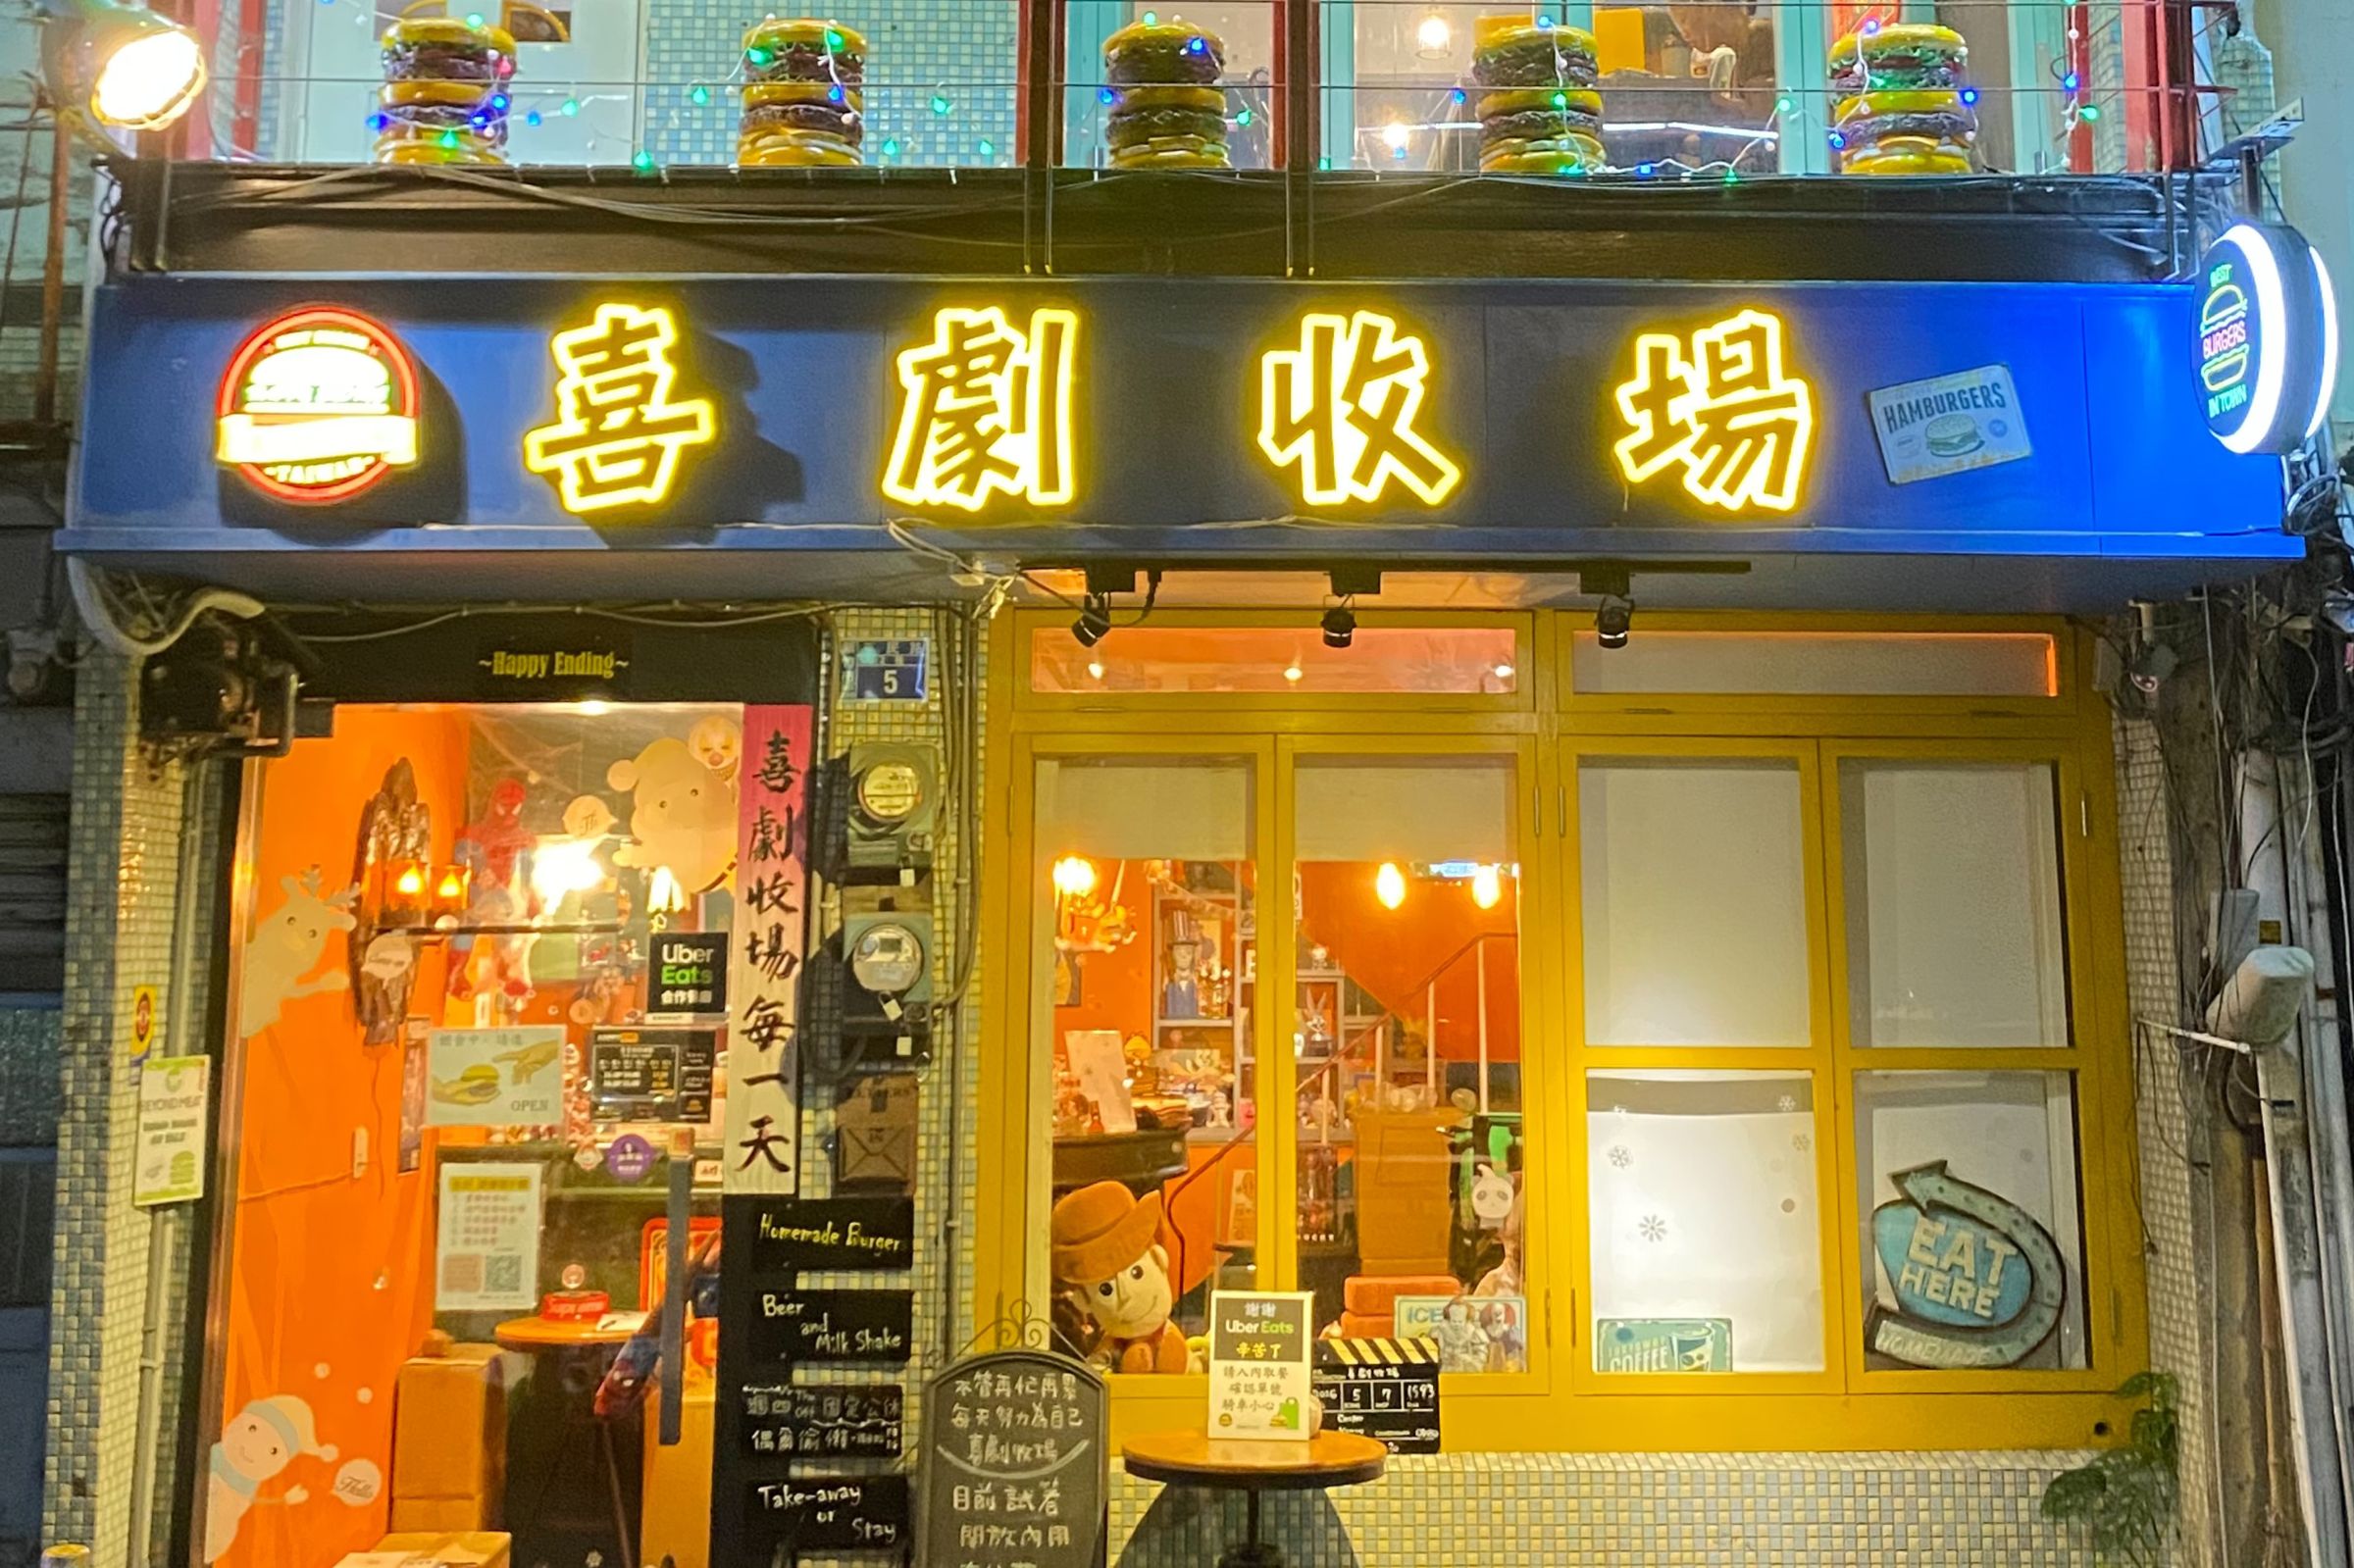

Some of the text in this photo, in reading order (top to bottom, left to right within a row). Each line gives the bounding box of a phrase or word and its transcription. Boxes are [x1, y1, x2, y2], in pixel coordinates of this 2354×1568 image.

[2210, 264, 2232, 288] BEST
[2203, 320, 2246, 360] BURGERS
[524, 302, 1813, 512] 喜劇收場
[1882, 381, 2007, 434] HAMBURGERS
[884, 670, 898, 694] 5
[662, 943, 714, 964] Uber
[734, 729, 802, 1174] 喜劇收場每一天
[661, 965, 713, 985] Eats
[510, 1099, 549, 1112] OPEN
[760, 1213, 900, 1257] Homemade Burger
[1909, 1213, 2019, 1287] EAT
[1898, 1261, 2001, 1319] HERE
[762, 1293, 804, 1317] Beer
[800, 1312, 828, 1336] and
[1225, 1319, 1295, 1335] Uber Eats
[815, 1327, 901, 1354] Milk Shake
[1236, 1341, 1281, 1359] 辛苦了
[1610, 1345, 1668, 1372] COFFEE
[1353, 1388, 1361, 1402] 5
[757, 1484, 861, 1510] Take-away
[816, 1510, 835, 1523] or
[851, 1518, 896, 1543] Stay
